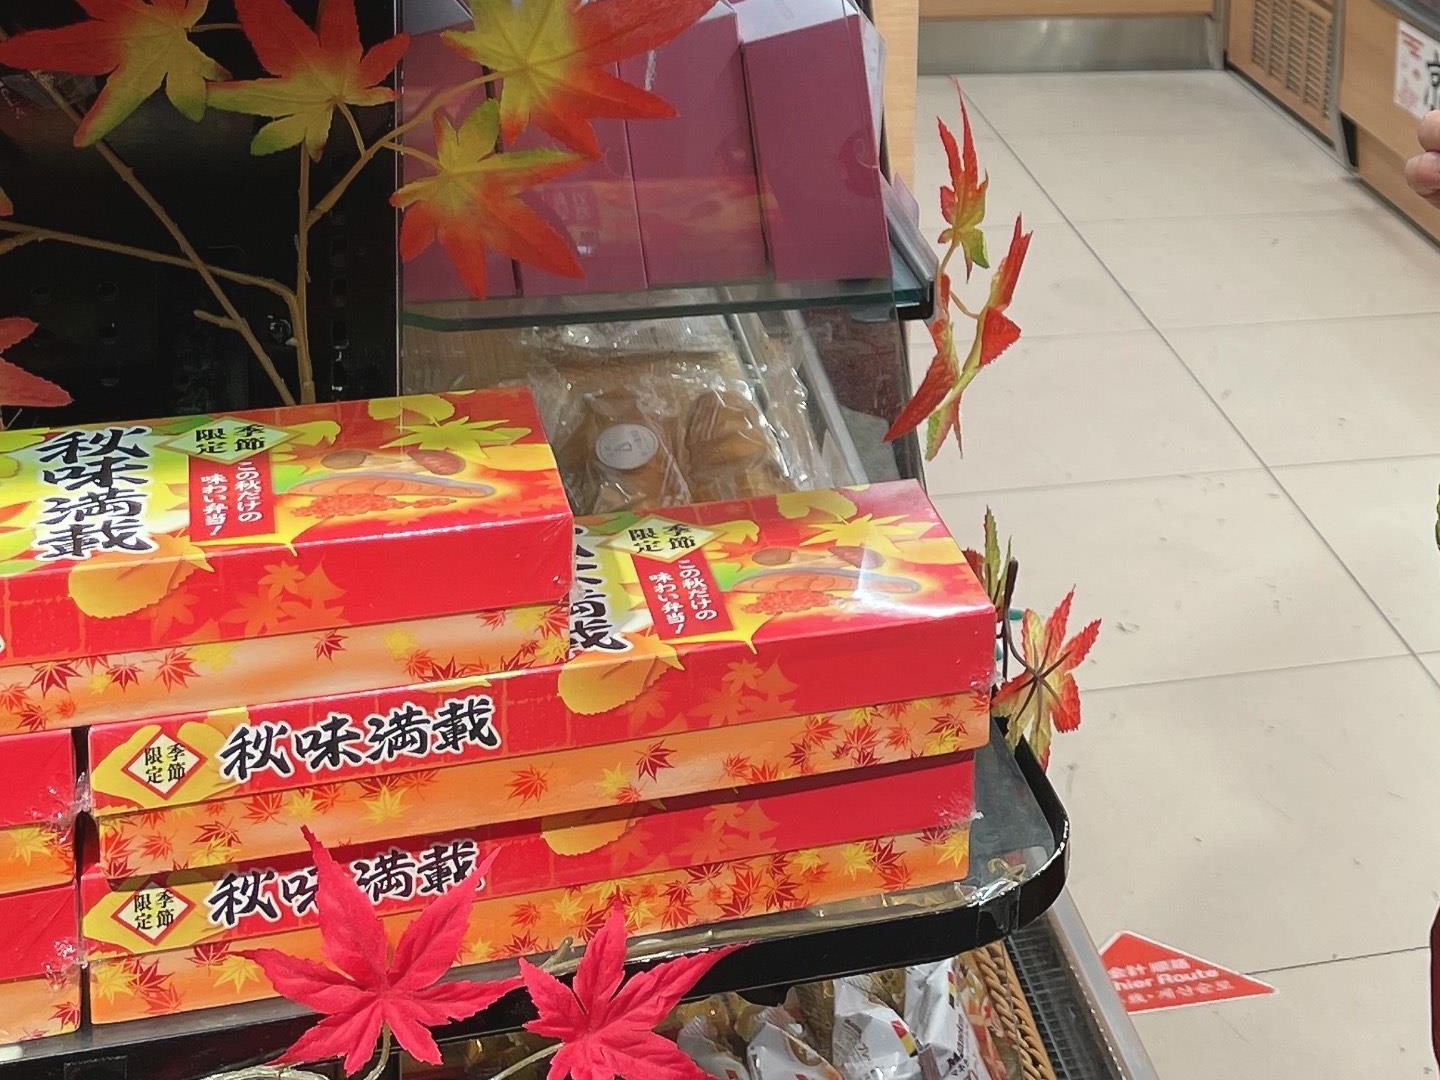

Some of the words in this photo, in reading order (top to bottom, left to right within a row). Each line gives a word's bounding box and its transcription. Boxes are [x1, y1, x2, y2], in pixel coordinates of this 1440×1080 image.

[195, 428, 227, 455] 限定
[233, 423, 265, 451] 季節
[37, 427, 153, 557] 秋味満載
[234, 461, 263, 522] この秋だけの
[628, 527, 664, 553] 限定
[663, 523, 697, 550] 季節
[678, 559, 718, 621] この秋だけの
[220, 698, 501, 781] 秋味満載
[143, 746, 163, 784] 限定
[166, 743, 187, 780] 季節
[133, 890, 152, 931] 限定
[155, 889, 176, 928] 季節
[1156, 968, 1219, 985] Route
